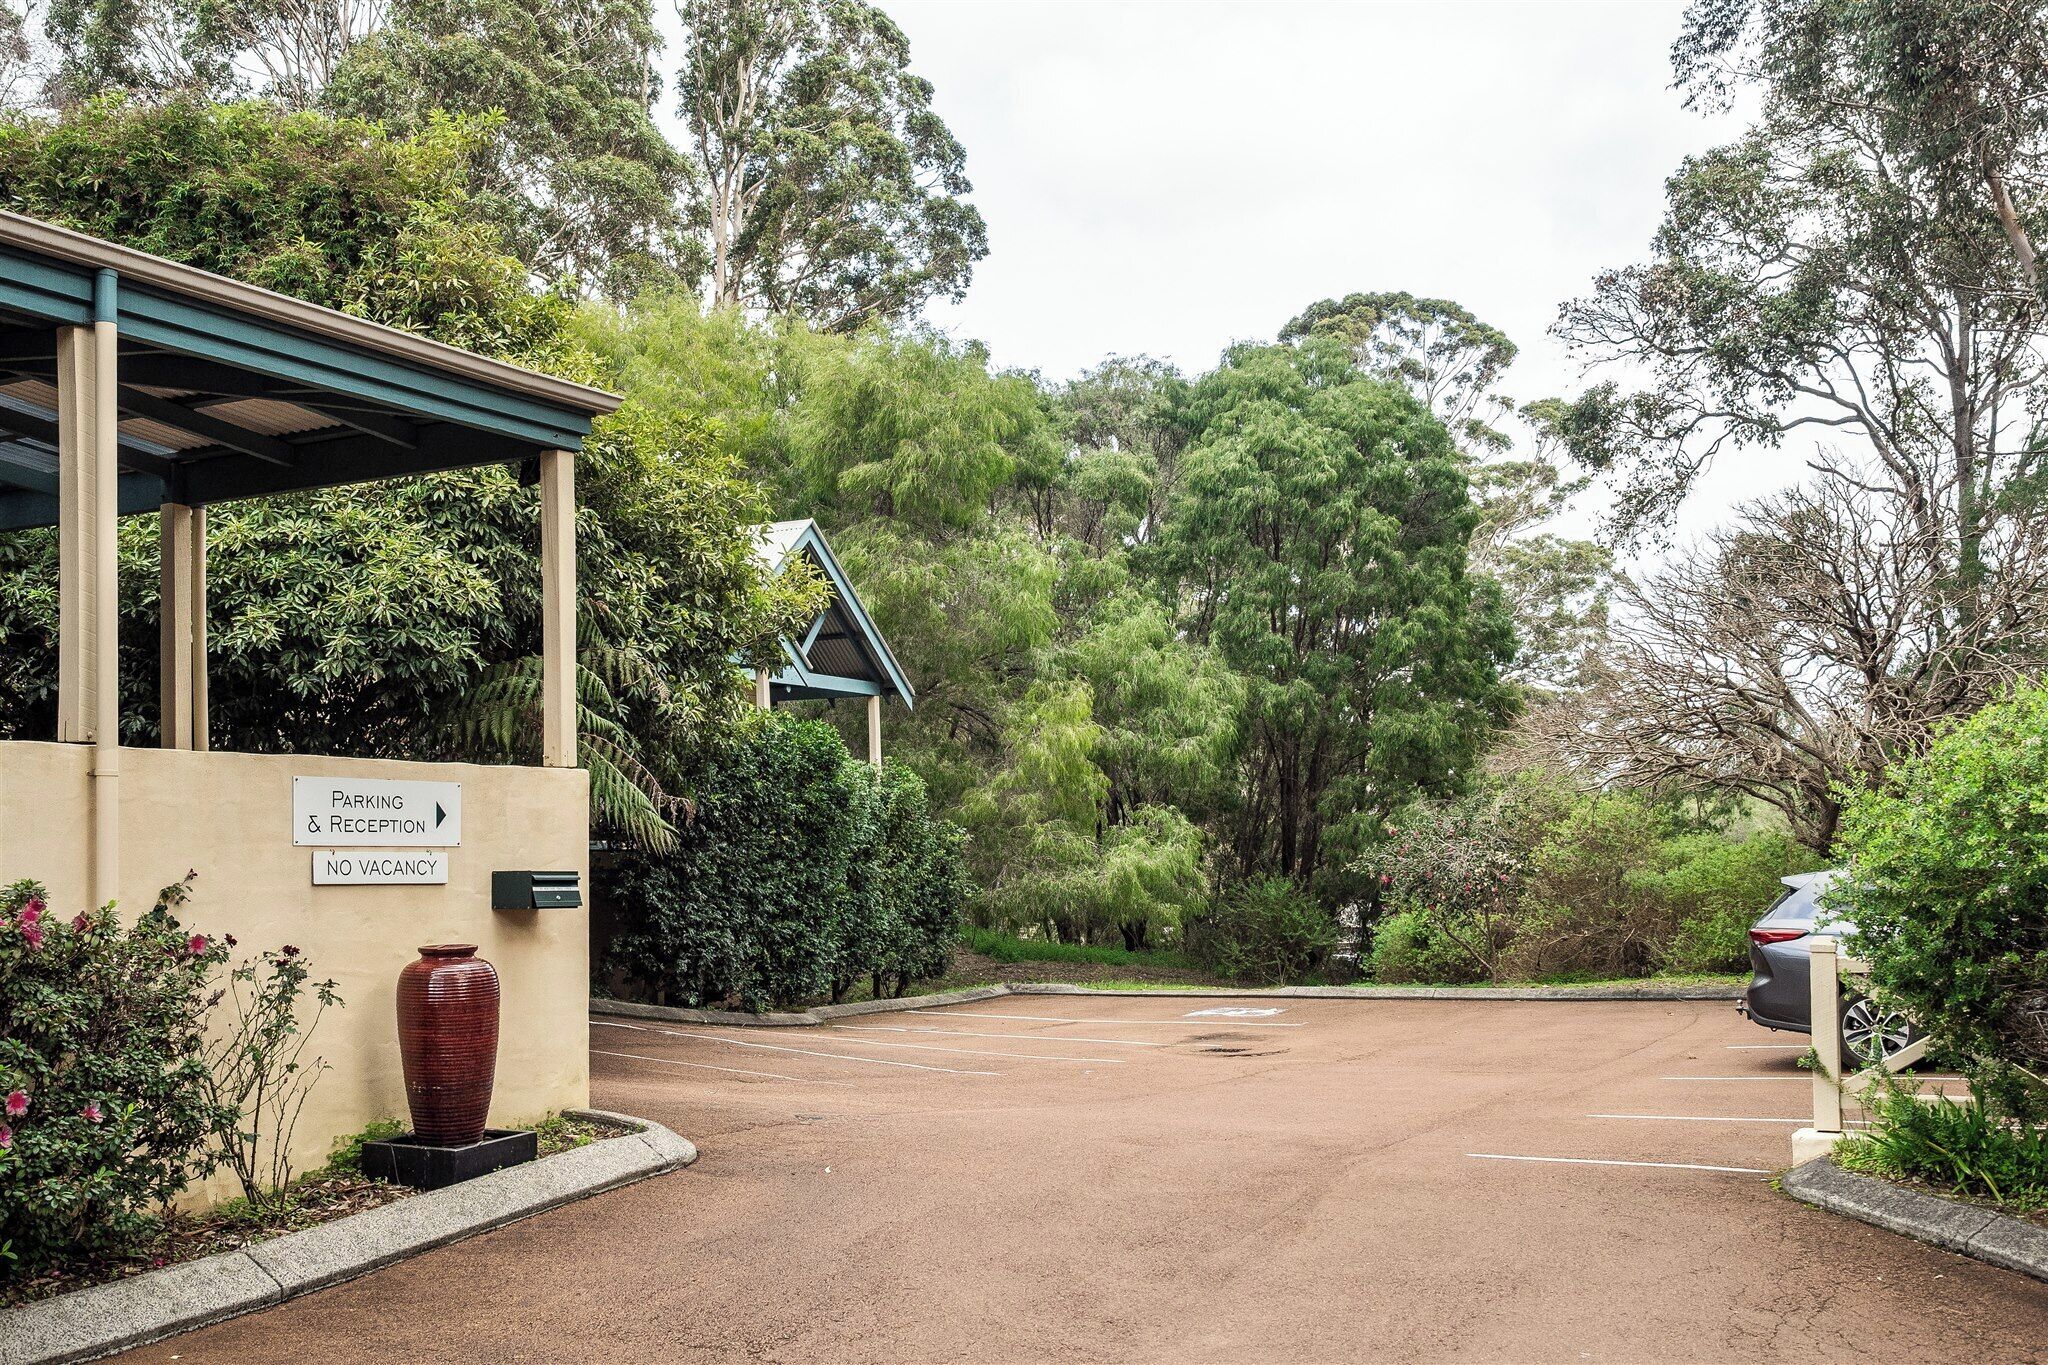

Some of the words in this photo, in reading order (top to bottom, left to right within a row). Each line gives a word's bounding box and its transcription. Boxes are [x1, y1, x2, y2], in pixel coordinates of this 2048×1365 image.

[307, 814, 322, 834] &
[327, 859, 352, 876] NO
[359, 859, 438, 876] VACANCY
